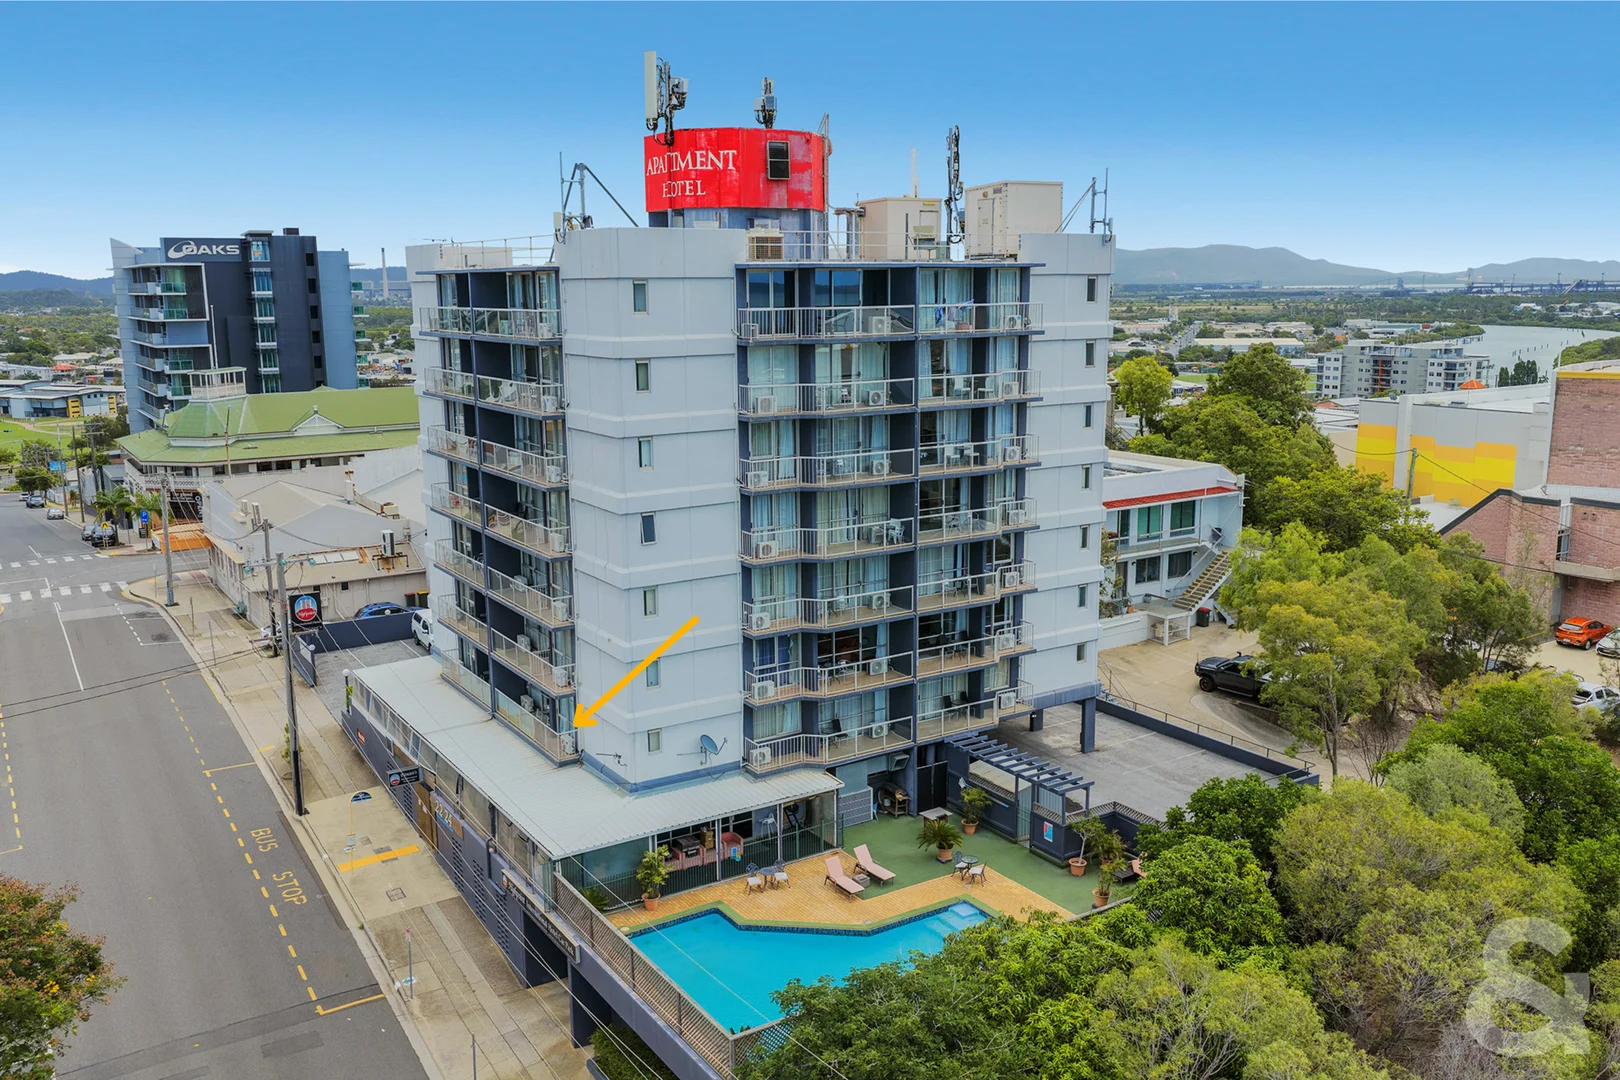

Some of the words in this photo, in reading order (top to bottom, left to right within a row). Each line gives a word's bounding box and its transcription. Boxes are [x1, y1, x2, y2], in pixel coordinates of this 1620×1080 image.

[179, 243, 240, 256] OAKS
[250, 827, 279, 852] BUS
[272, 871, 307, 905] STOP
